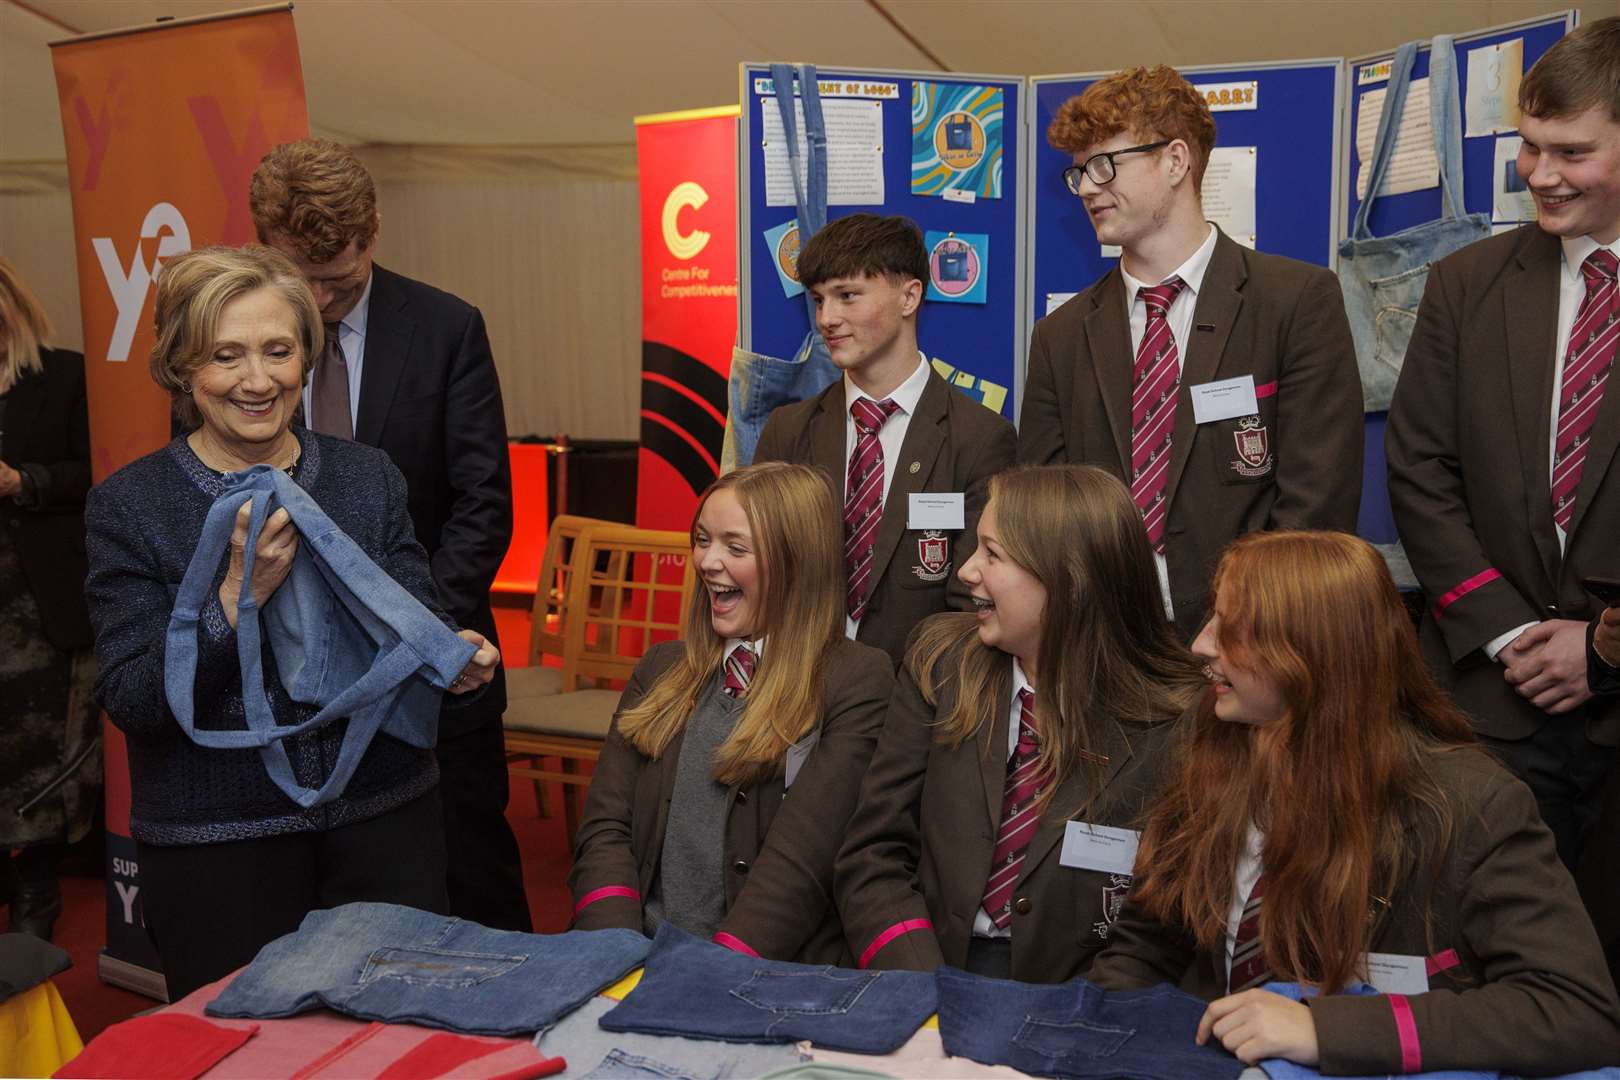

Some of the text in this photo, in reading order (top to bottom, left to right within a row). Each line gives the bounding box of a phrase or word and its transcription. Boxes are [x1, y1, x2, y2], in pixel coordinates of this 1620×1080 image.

[1199, 87, 1254, 106] ARRY
[662, 181, 711, 260] C
[691, 266, 710, 280] For
[113, 880, 145, 928] Y
